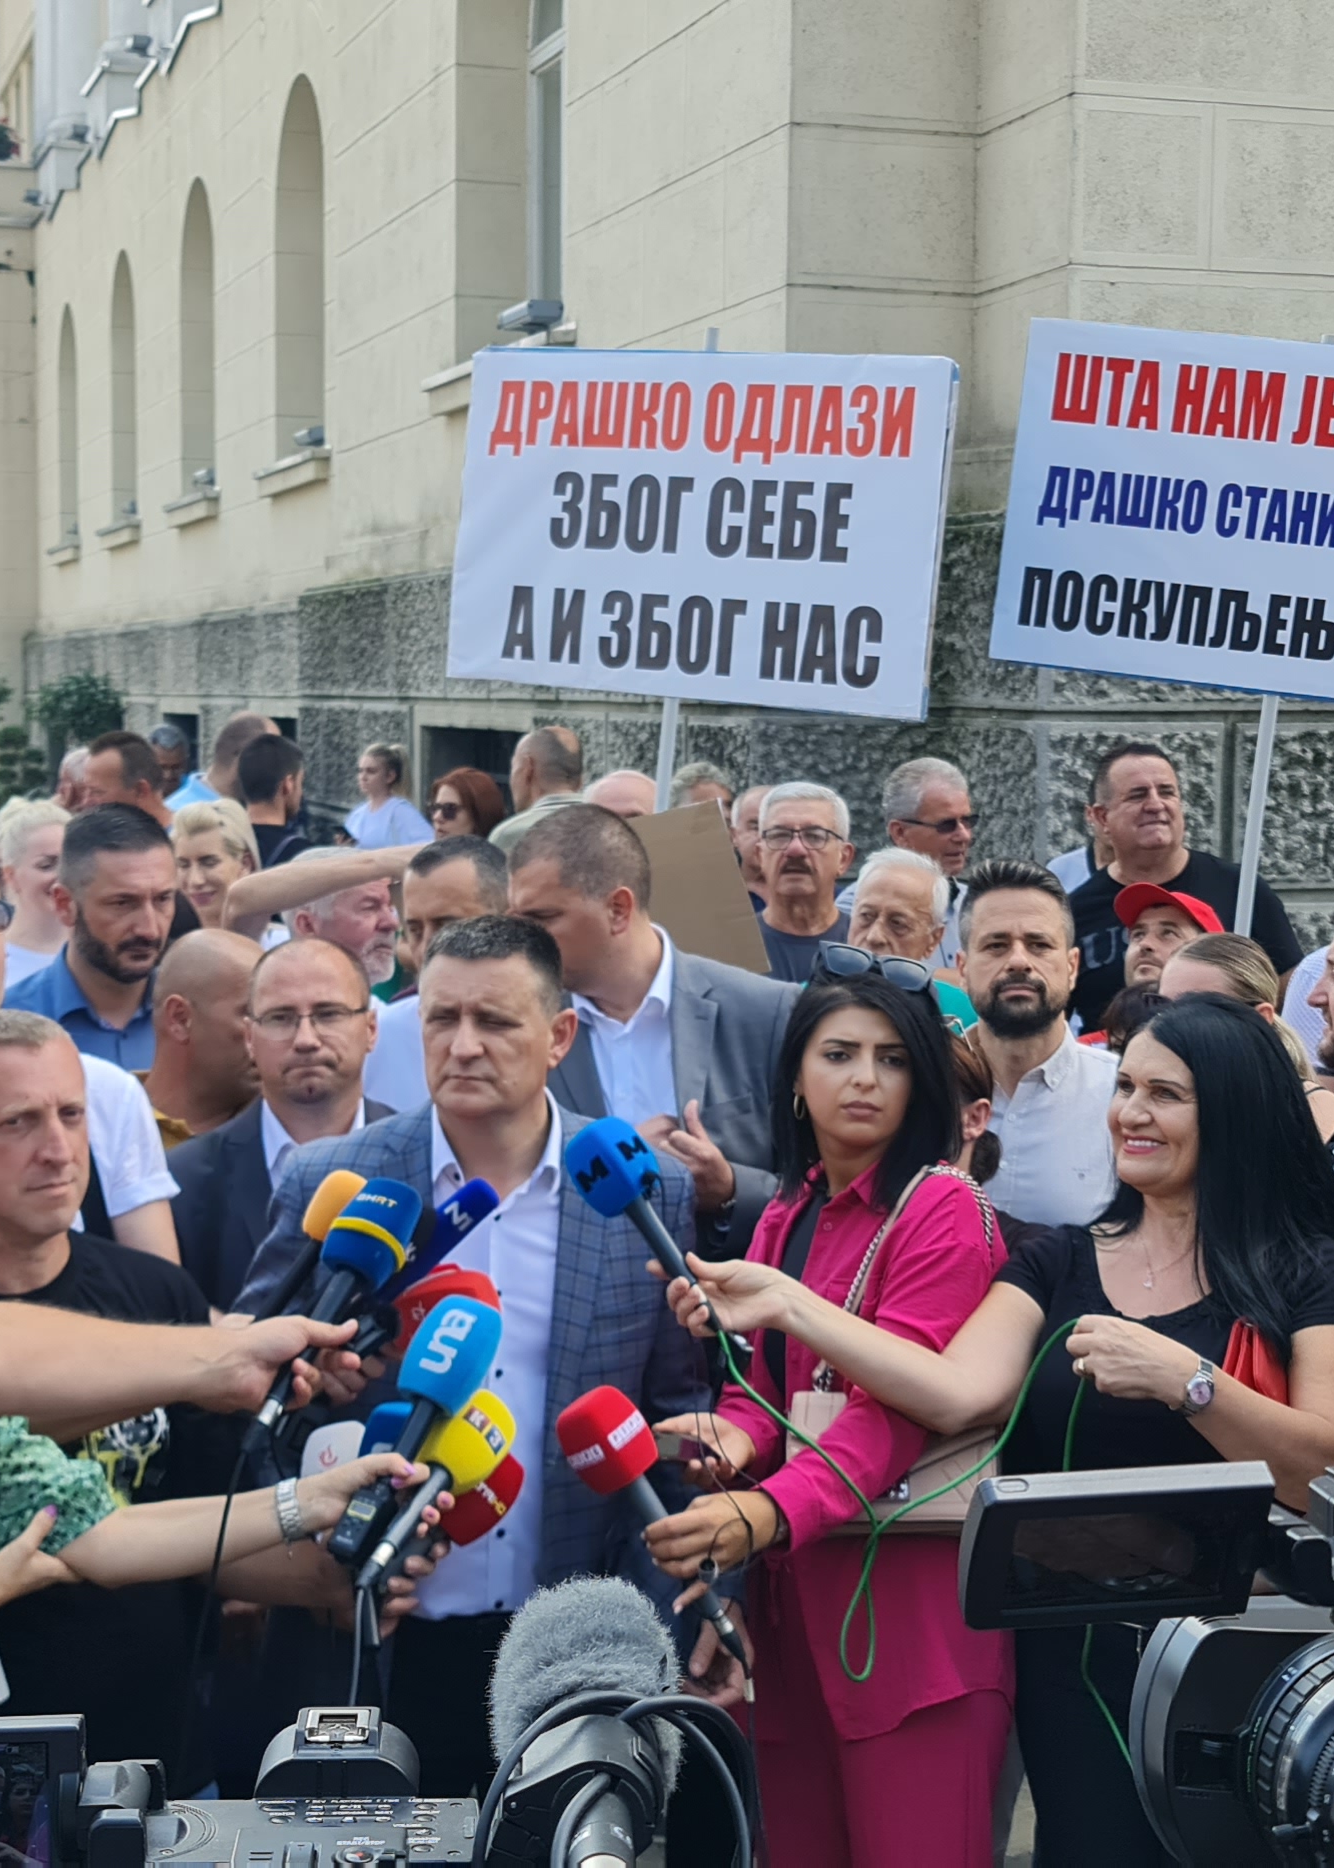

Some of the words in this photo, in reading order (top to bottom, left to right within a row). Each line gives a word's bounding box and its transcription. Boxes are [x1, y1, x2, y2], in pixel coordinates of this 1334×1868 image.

[488, 380, 692, 456] ДРАШКО
[703, 381, 916, 465] ОДЛАЗИ
[1051, 352, 1159, 431] ШТА
[1171, 364, 1286, 443] НАМ
[550, 471, 694, 554] ЗБОГ
[706, 477, 853, 563] СЕБЕ
[1037, 466, 1207, 534] ДРАШКО
[501, 585, 534, 661] А
[549, 587, 586, 664] И
[599, 590, 748, 677] ЗБОГ
[760, 601, 883, 688] НАС
